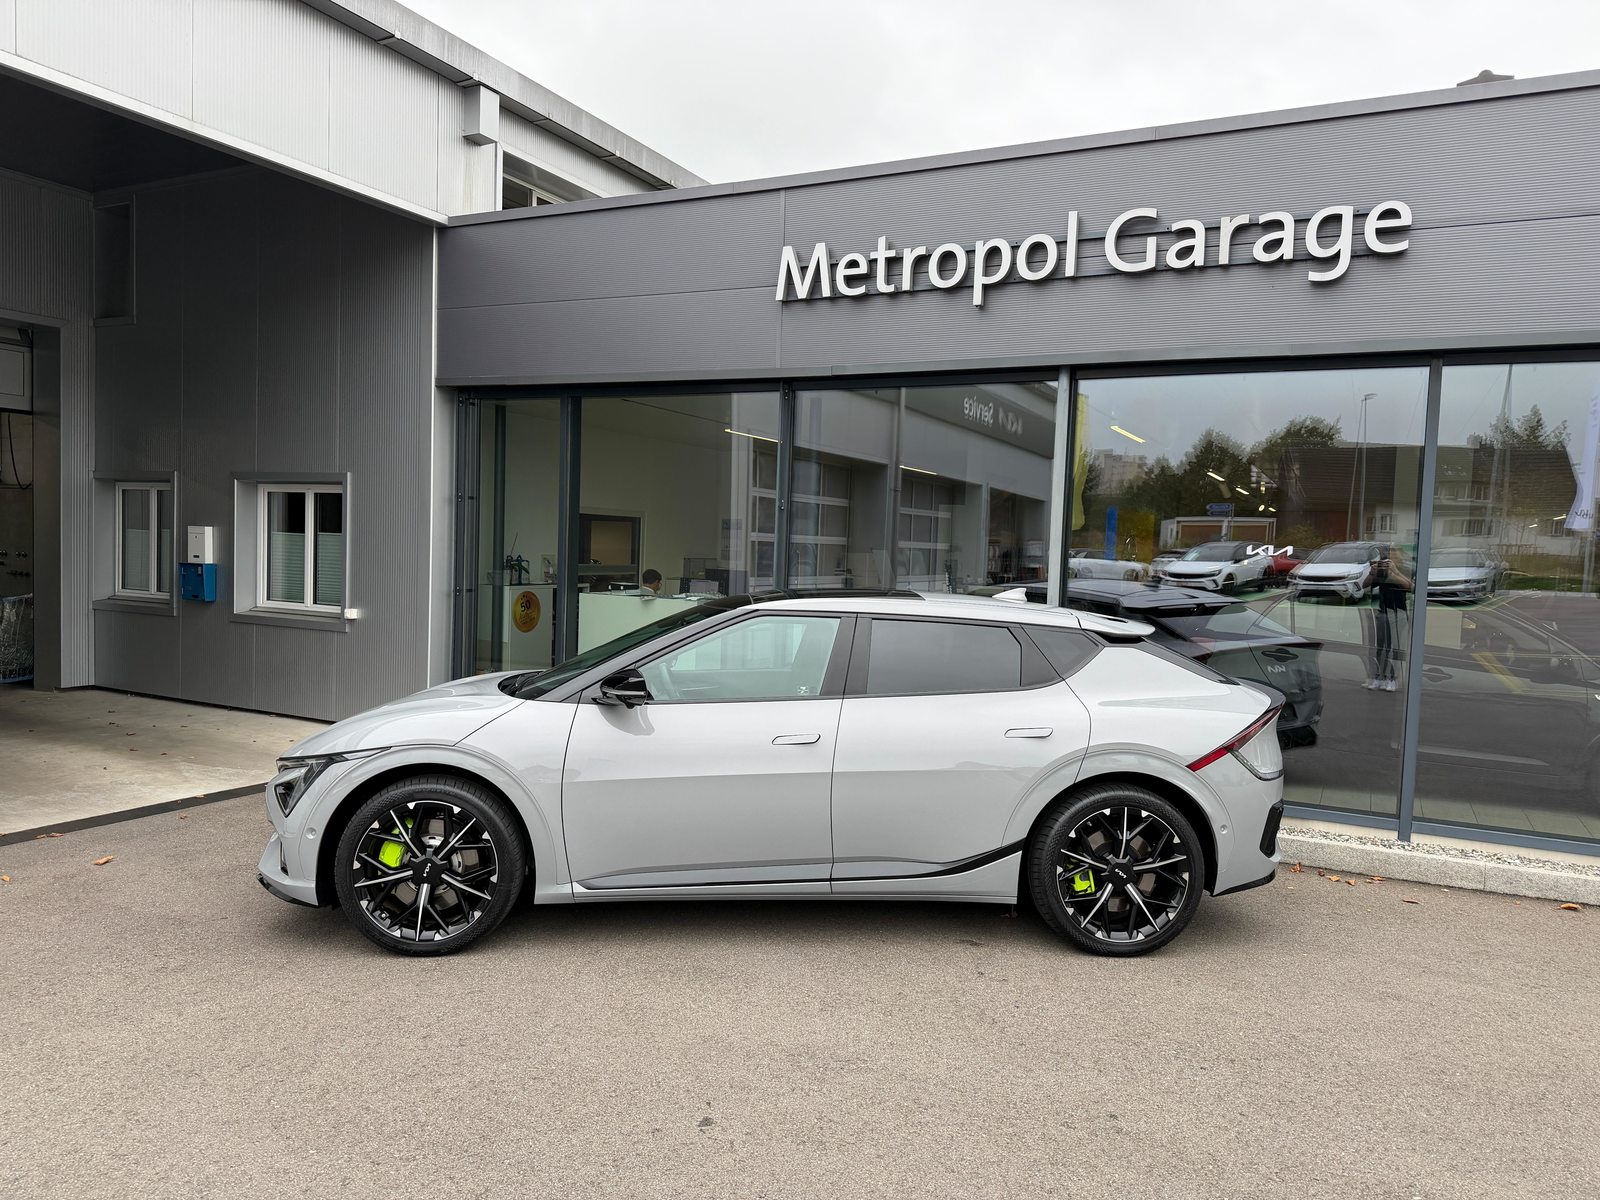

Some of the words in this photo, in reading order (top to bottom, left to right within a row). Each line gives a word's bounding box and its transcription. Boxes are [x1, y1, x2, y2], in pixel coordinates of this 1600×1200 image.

[775, 210, 1079, 306] Metropol
[1104, 199, 1413, 283] Garage
[1246, 544, 1294, 557] KIA
